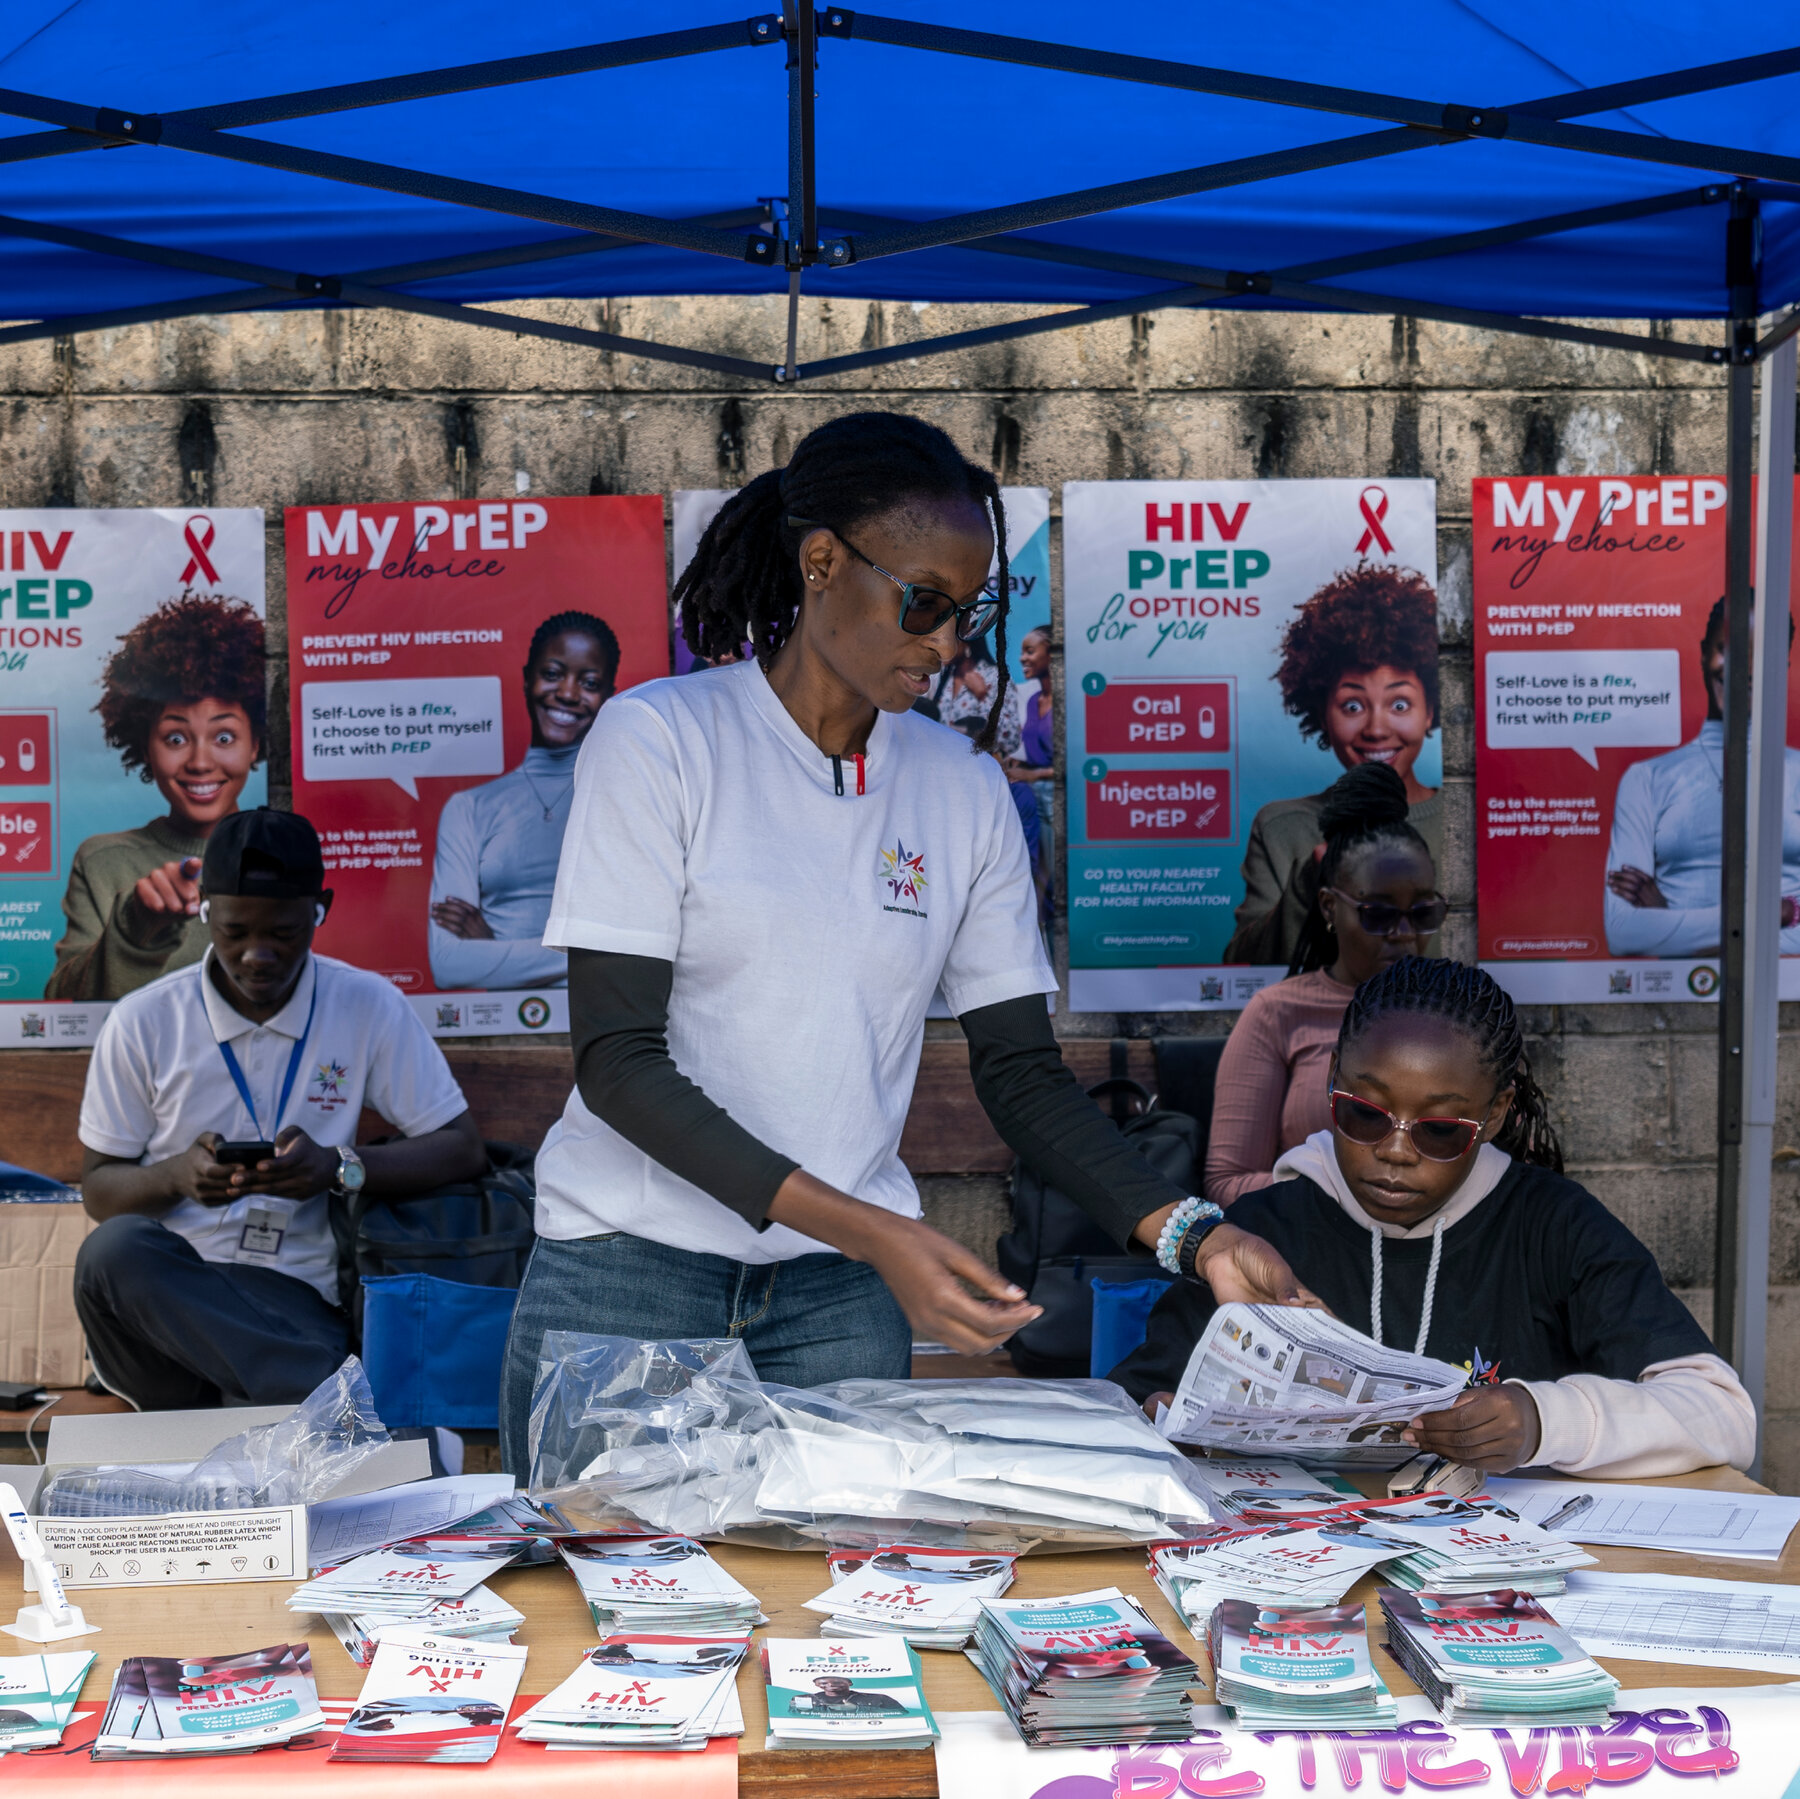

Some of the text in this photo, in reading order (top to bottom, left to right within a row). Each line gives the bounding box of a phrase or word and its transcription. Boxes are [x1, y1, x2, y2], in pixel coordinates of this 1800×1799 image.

[1492, 479, 1728, 542] My PrEP
[1145, 502, 1251, 542] HIV
[306, 503, 548, 571] My PrEP
[1491, 493, 1685, 590] my choice
[305, 519, 505, 619] my choice
[1128, 549, 1271, 590] PrEP
[1129, 596, 1261, 618] OPTIONS
[1487, 603, 1682, 619] PREVENT HIV INFECTION
[1086, 592, 1209, 659] for you
[1488, 622, 1575, 636] WITH PrEP
[302, 630, 503, 650] PREVENT HIV INFECTION
[303, 651, 391, 667] WITH PrEP
[1091, 678, 1098, 690] 1
[1496, 674, 1637, 690] Self-Love is a flex,
[1133, 694, 1181, 715] Oral
[1496, 691, 1671, 709] I choose to put myself
[312, 702, 457, 721] Self-Love is a flex,
[1496, 710, 1612, 725] first with PrEP
[312, 719, 493, 739] I choose to put myself
[1129, 723, 1186, 742] PrEP
[312, 741, 431, 757] first with PrEP
[1092, 766, 1100, 777] 2
[1100, 781, 1217, 806] Injectable
[1488, 796, 1596, 810] Go to the nearest
[1130, 809, 1187, 828] PrEP
[1488, 810, 1600, 825] Health Facility for
[326, 828, 418, 842] to the nearest
[1488, 823, 1600, 839] your PrEP options
[352, 842, 422, 856] Facility for
[340, 857, 423, 870] PrEP options
[1084, 867, 1221, 880] GO TO YOUR NEAREST
[1100, 882, 1206, 893] HEALTH FACILITY
[1074, 895, 1231, 908] FOR MORE INFORMATION
[221, 1520, 245, 1528] DIRECT
[247, 1518, 281, 1526] SUNLIGHT
[103, 1540, 137, 1548] ALLERGIC
[181, 1537, 218, 1545] INCLUDING
[220, 1534, 273, 1543] ANAPHYLACTIC
[171, 1530, 202, 1538] NATURAL
[204, 1528, 233, 1536] RUBBER
[1448, 1533, 1511, 1546] HIV
[168, 1545, 202, 1553] ALLERGIC
[1468, 1540, 1532, 1551] TESTING
[1256, 1552, 1315, 1569] TESTING
[1268, 1547, 1336, 1564] HIV
[384, 1570, 456, 1579] HIV
[611, 1577, 679, 1587] HIV
[852, 1599, 925, 1613] TESTING
[859, 1590, 934, 1606] HIV
[1020, 1623, 1132, 1636] PREVENTION
[1428, 1623, 1520, 1637] HIV
[1043, 1630, 1137, 1648] HIV
[1248, 1635, 1343, 1651] HIV
[1431, 1634, 1545, 1643] PREVENTION
[805, 1655, 871, 1664] PEP
[1240, 1646, 1355, 1657] PREVENTION
[408, 1655, 488, 1667] TESTING
[406, 1665, 483, 1680] HIV
[176, 1689, 293, 1711] PREVENTION
[180, 1680, 277, 1704] HIV
[586, 1691, 667, 1707] HIV
[579, 1704, 660, 1713] TESTING
[1112, 1729, 1266, 1799] BE
[1253, 1719, 1491, 1788] THE
